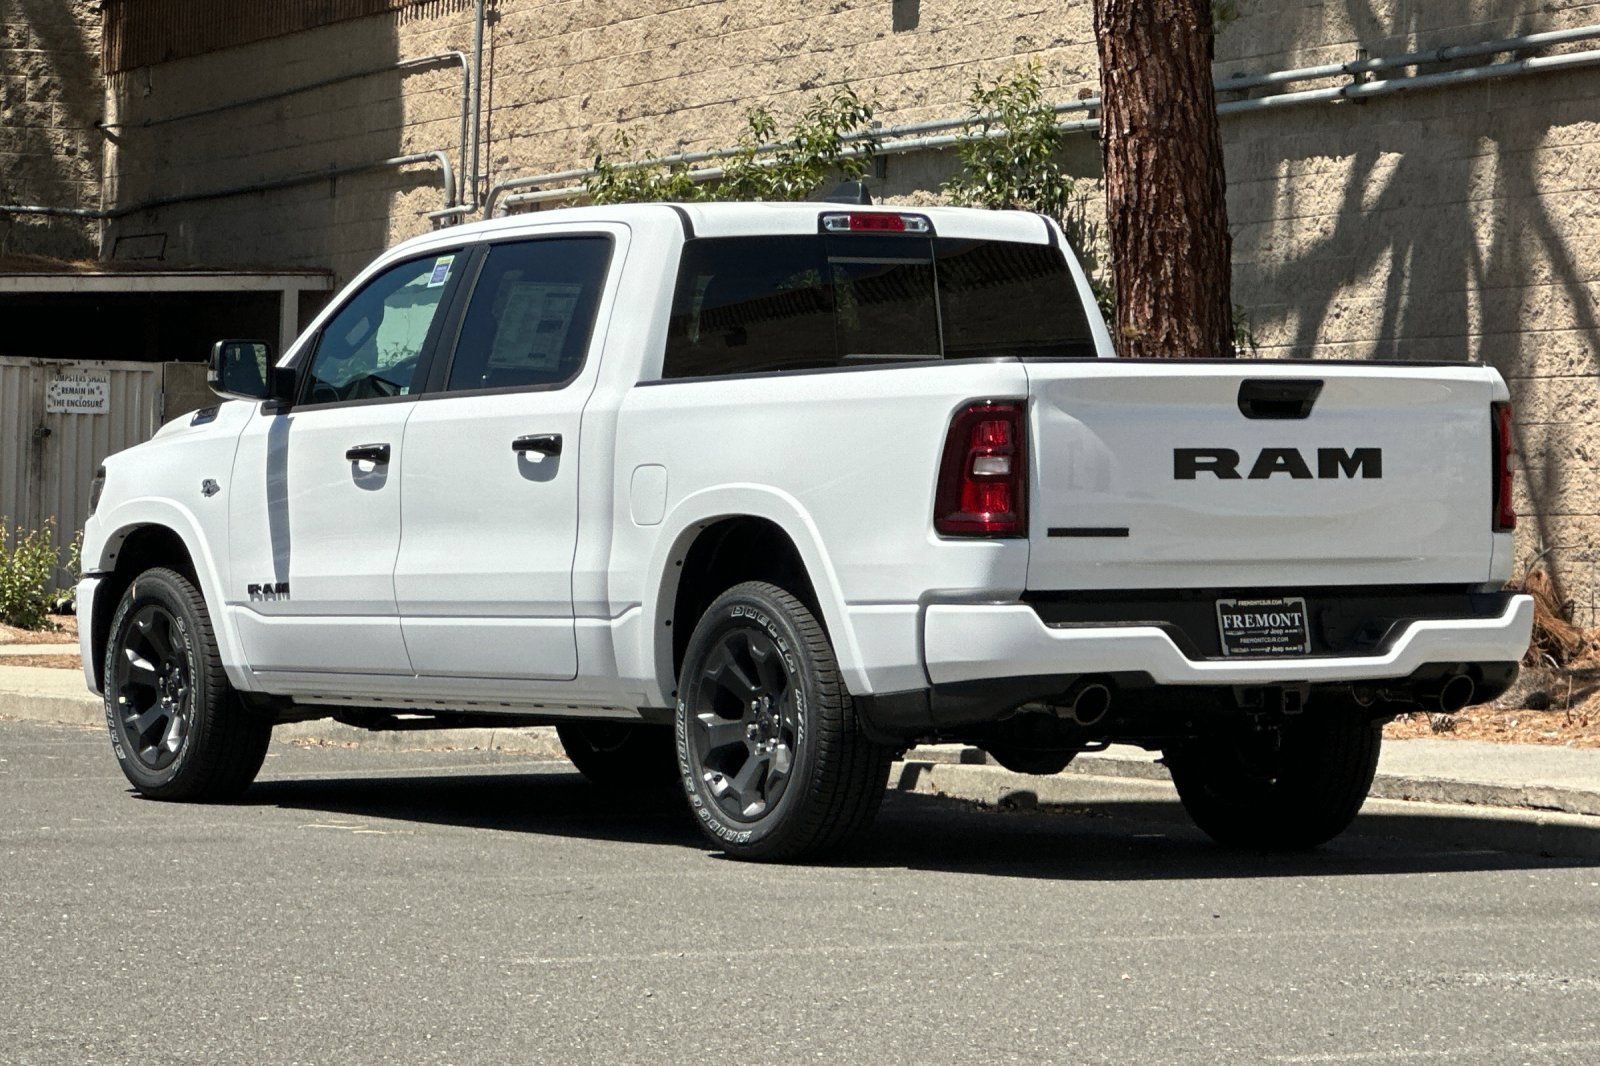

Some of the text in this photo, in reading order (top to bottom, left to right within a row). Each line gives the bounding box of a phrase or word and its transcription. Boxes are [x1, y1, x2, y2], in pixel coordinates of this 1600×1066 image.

[61, 386, 95, 395] REMAIN IN
[53, 399, 104, 408] THE ENCLOSURE
[1173, 447, 1383, 480] RAM
[247, 582, 290, 595] RAM
[1222, 612, 1302, 629] FREMONT
